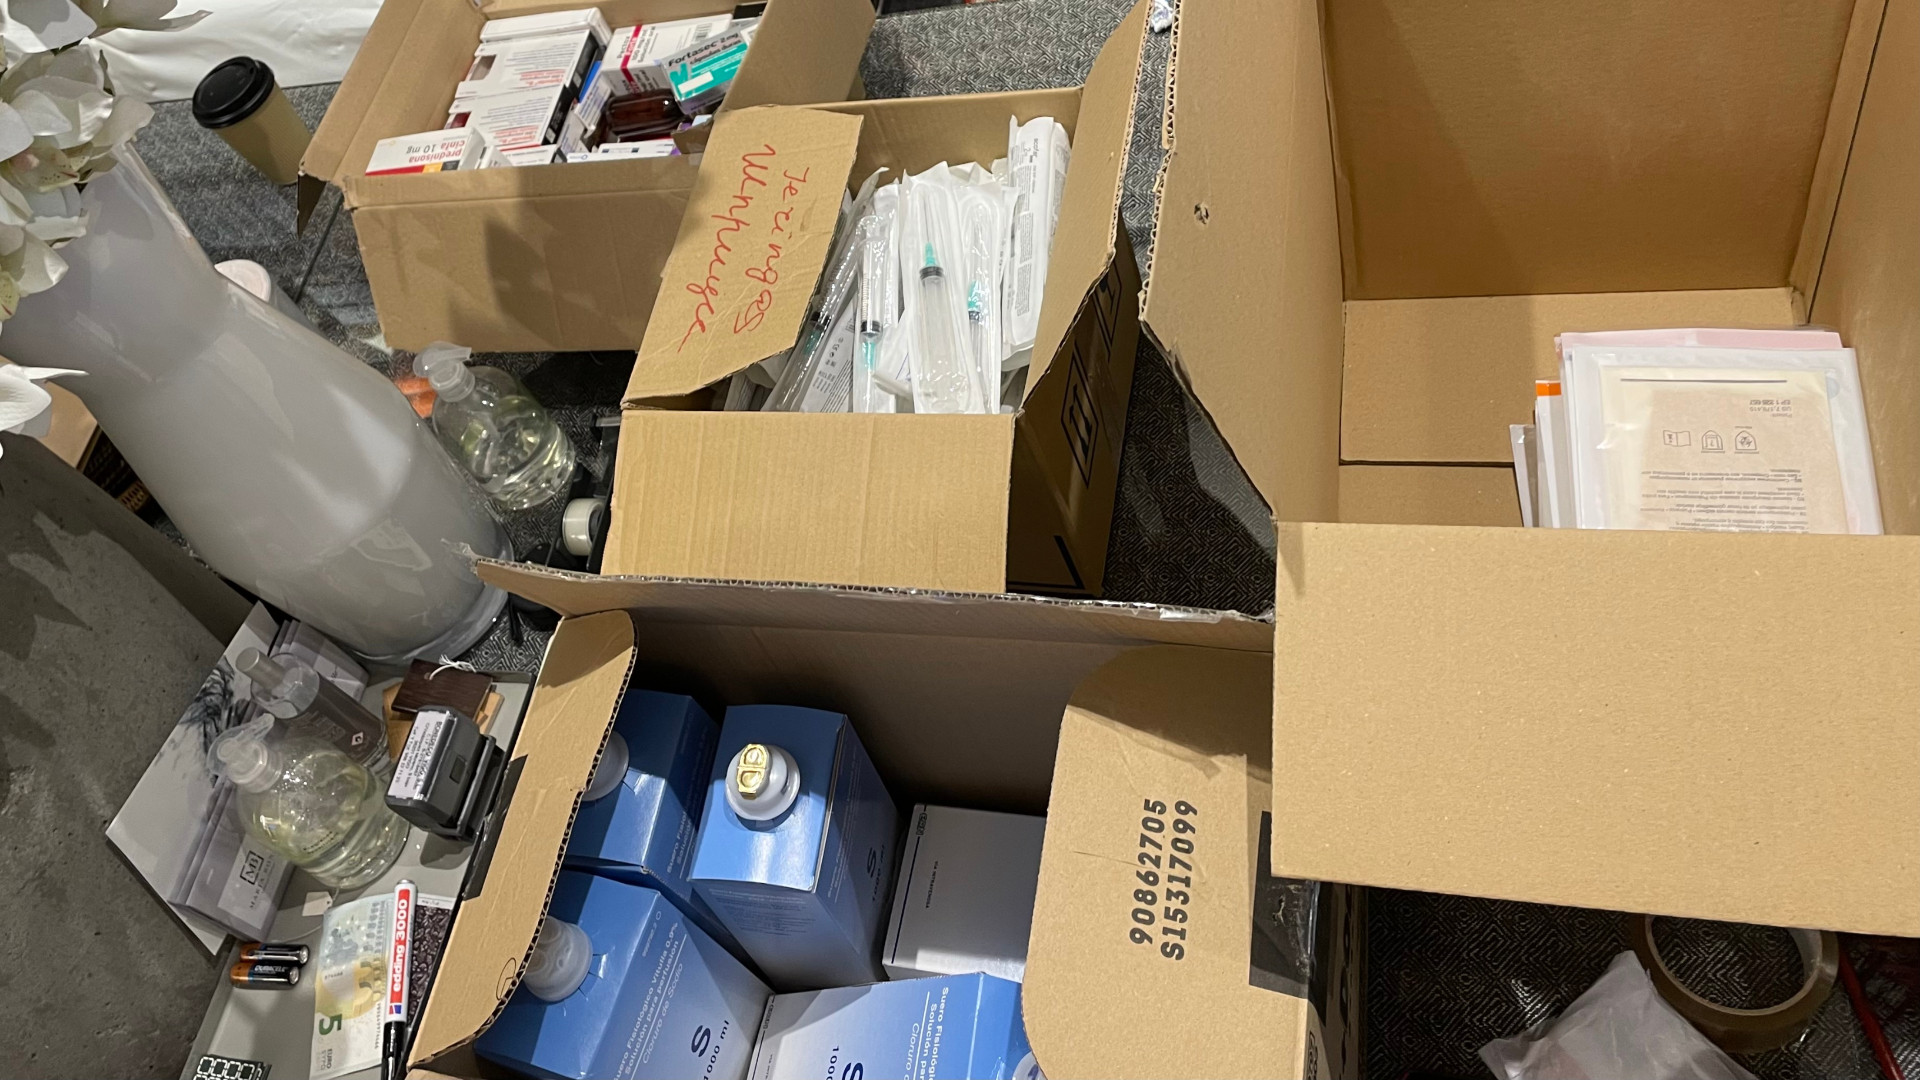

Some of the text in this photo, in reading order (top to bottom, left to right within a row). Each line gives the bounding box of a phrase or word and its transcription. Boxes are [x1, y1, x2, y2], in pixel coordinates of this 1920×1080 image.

[668, 40, 718, 67] Fortasec
[406, 140, 466, 155] cinfa 10 mg
[408, 148, 463, 164] prednisona
[1129, 798, 1167, 945] 90862705
[393, 899, 408, 992] edding 3000
[318, 1013, 343, 1036] 5
[627, 987, 654, 1050] Fisiológico
[642, 962, 683, 1064] Cloruro de Sodio
[937, 986, 949, 1022] Suero
[625, 1023, 648, 1075] Solución
[646, 995, 658, 1022] para
[691, 1024, 711, 1058] S
[720, 1019, 730, 1040] ml
[905, 1022, 920, 1071] Cloruro
[923, 1003, 938, 1057] Solución
